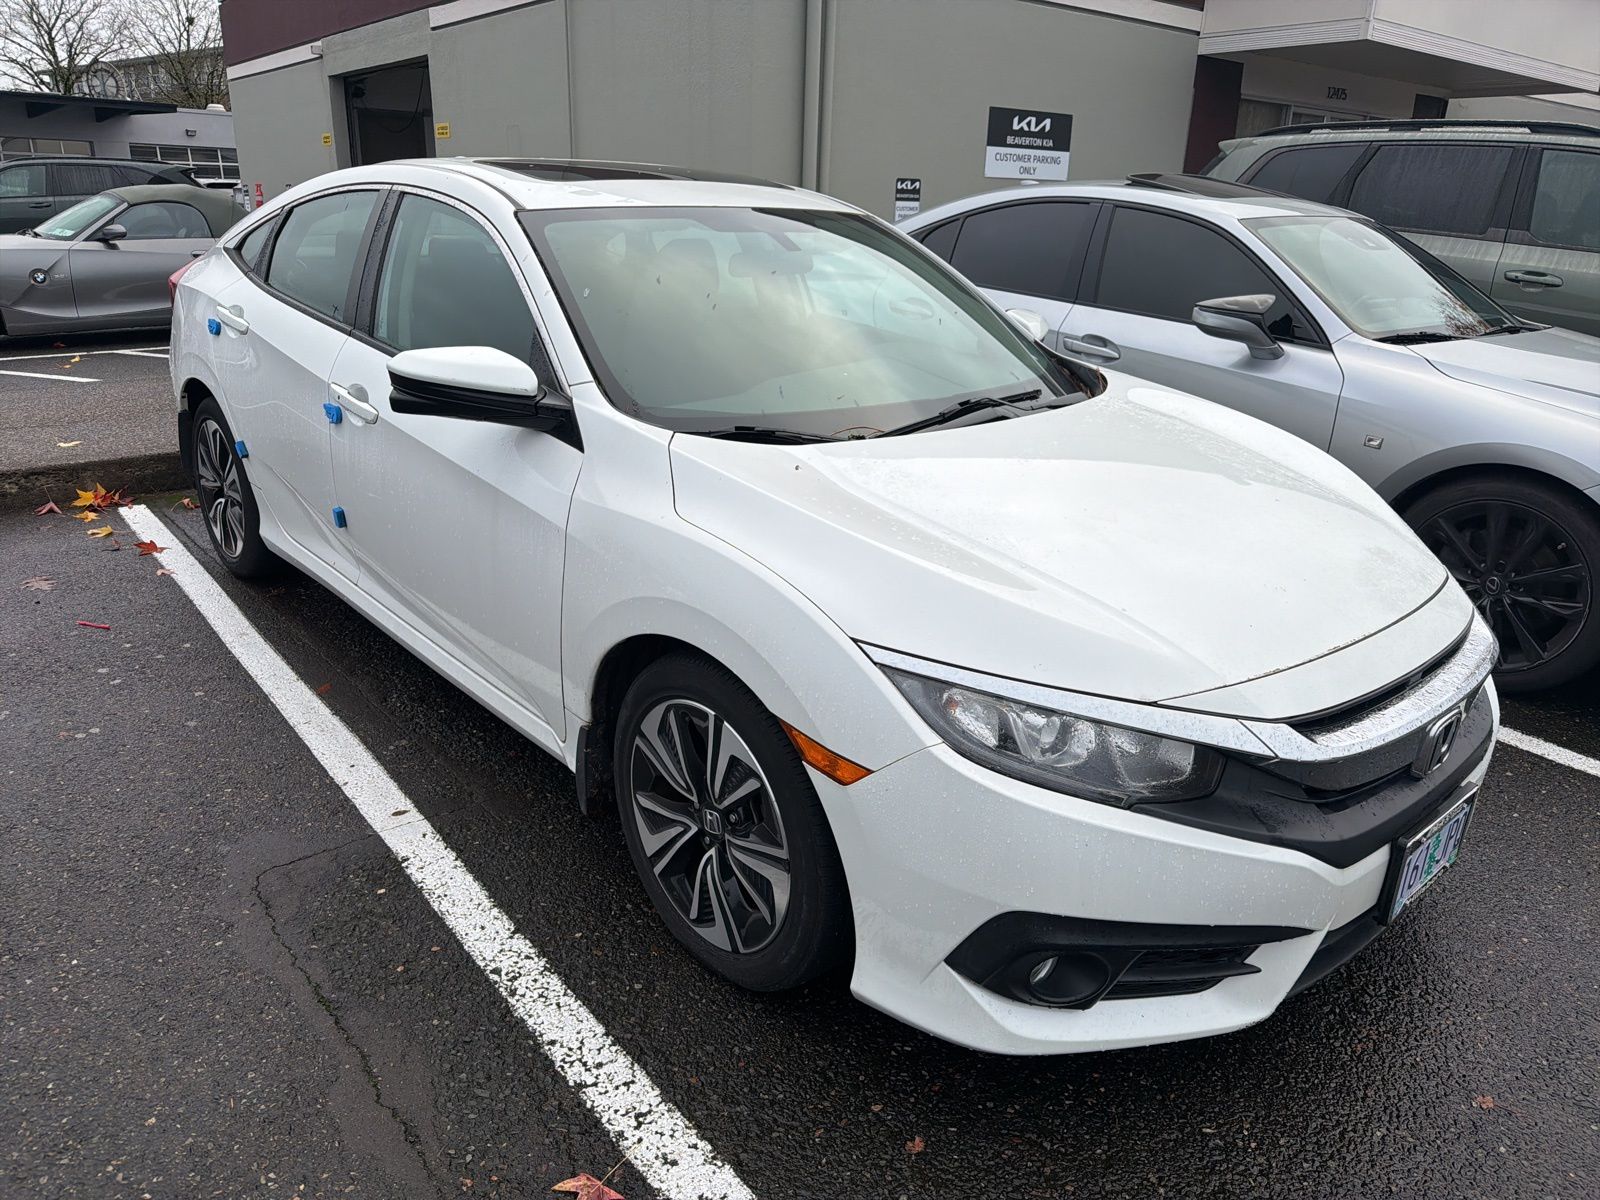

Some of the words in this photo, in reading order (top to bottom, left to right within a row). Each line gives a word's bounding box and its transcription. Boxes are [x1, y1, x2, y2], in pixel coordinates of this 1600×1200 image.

[1012, 115, 1051, 133] KIA
[1006, 135, 1042, 147] BEAVERTON
[1043, 138, 1053, 148] KIA
[994, 152, 1032, 164] CUSTOMER
[1032, 155, 1061, 166] PARKING
[1018, 165, 1037, 176] ONLY
[896, 180, 920, 190] KIA
